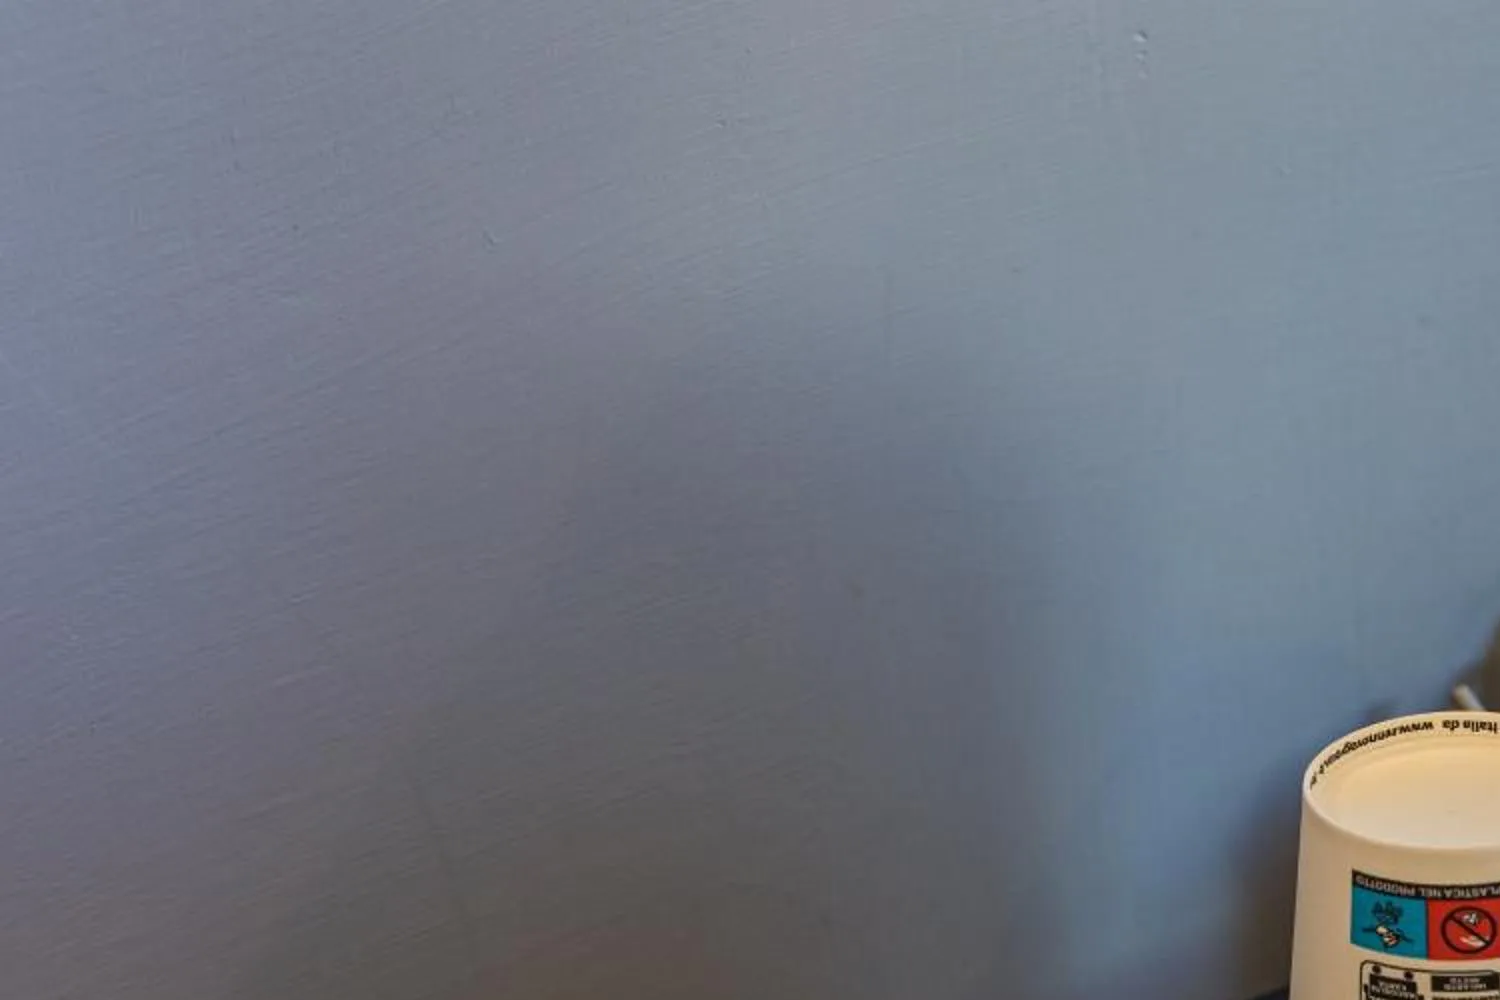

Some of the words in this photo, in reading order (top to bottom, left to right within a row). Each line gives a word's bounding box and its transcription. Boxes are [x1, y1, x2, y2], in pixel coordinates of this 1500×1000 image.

[1442, 719, 1461, 731] da
[1463, 719, 1499, 734] Italia
[1418, 885, 1442, 899] NEL
